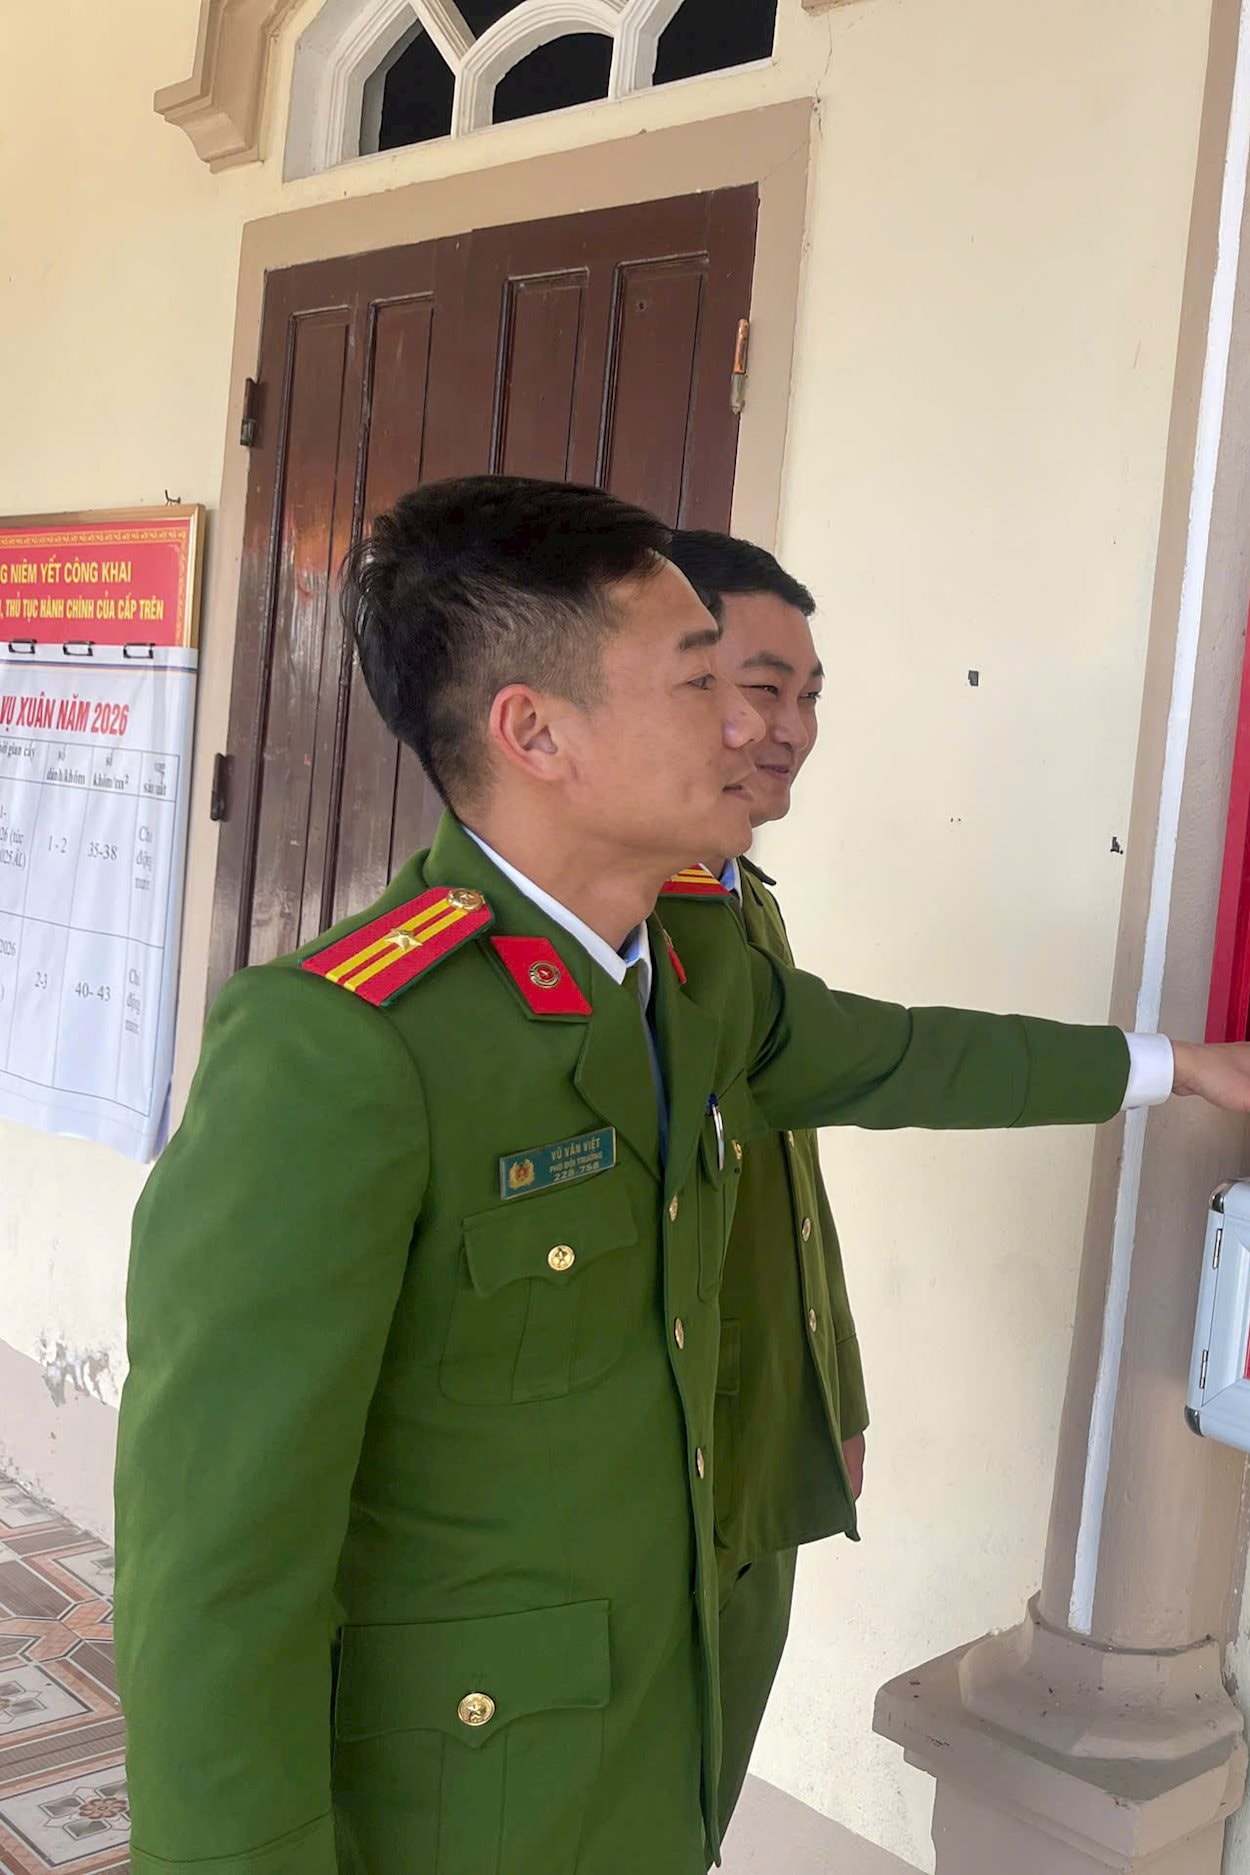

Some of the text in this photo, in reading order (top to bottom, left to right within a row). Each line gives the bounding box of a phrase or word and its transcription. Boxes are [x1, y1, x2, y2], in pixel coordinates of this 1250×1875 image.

[40, 553, 61, 584] YẾT
[63, 556, 99, 584] CÔNG
[102, 561, 132, 583] KHAI
[23, 599, 39, 623] TỤC
[40, 595, 64, 619] HÀNH
[66, 595, 94, 619] CHÍNH
[96, 590, 115, 619] CỦA
[118, 592, 137, 620] CẤP
[139, 594, 164, 620] TRÊN
[0, 690, 130, 736] VỤ XUÂN NĂM 2026
